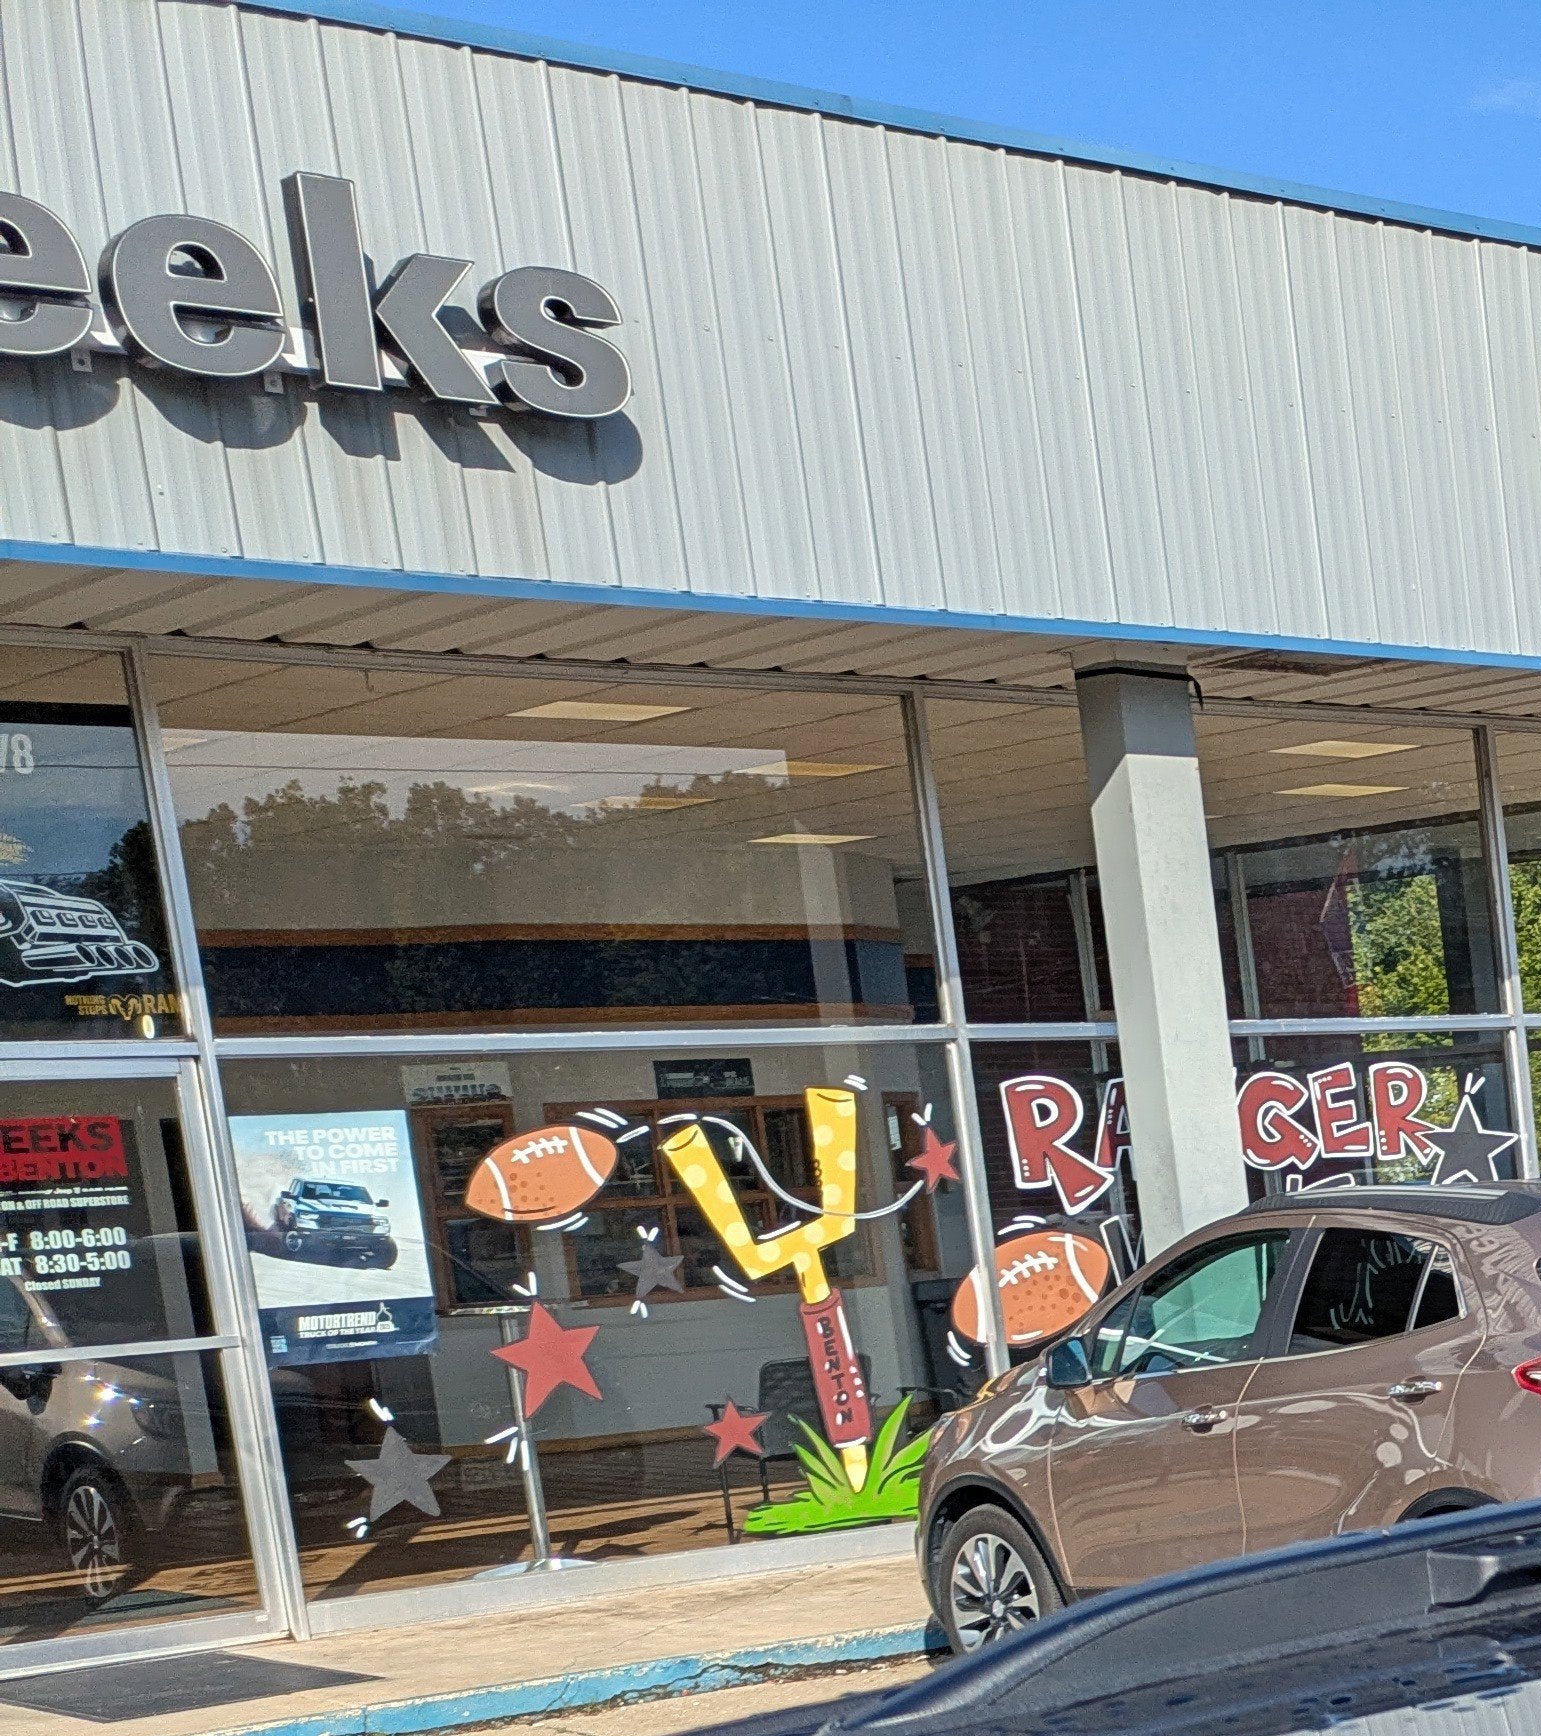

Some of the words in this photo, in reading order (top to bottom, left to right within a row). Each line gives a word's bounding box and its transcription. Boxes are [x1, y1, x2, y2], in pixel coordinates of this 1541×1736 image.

[0, 170, 632, 418] eeks
[264, 1129, 309, 1146] THE
[311, 1126, 396, 1143] POWER
[1000, 1061, 1438, 1214] RAGER
[294, 1144, 324, 1160] TO
[328, 1142, 398, 1159] COME
[310, 1160, 336, 1174] IN
[341, 1158, 398, 1174] FIRST
[69, 1195, 130, 1207] SUPERSTORE
[29, 1226, 127, 1250] 8:00-6:00
[34, 1250, 131, 1274] 8:30-5:00
[62, 1276, 101, 1289] SUNDAY
[298, 1311, 376, 1331] MOTORTREND
[817, 1316, 853, 1423] BENTON
